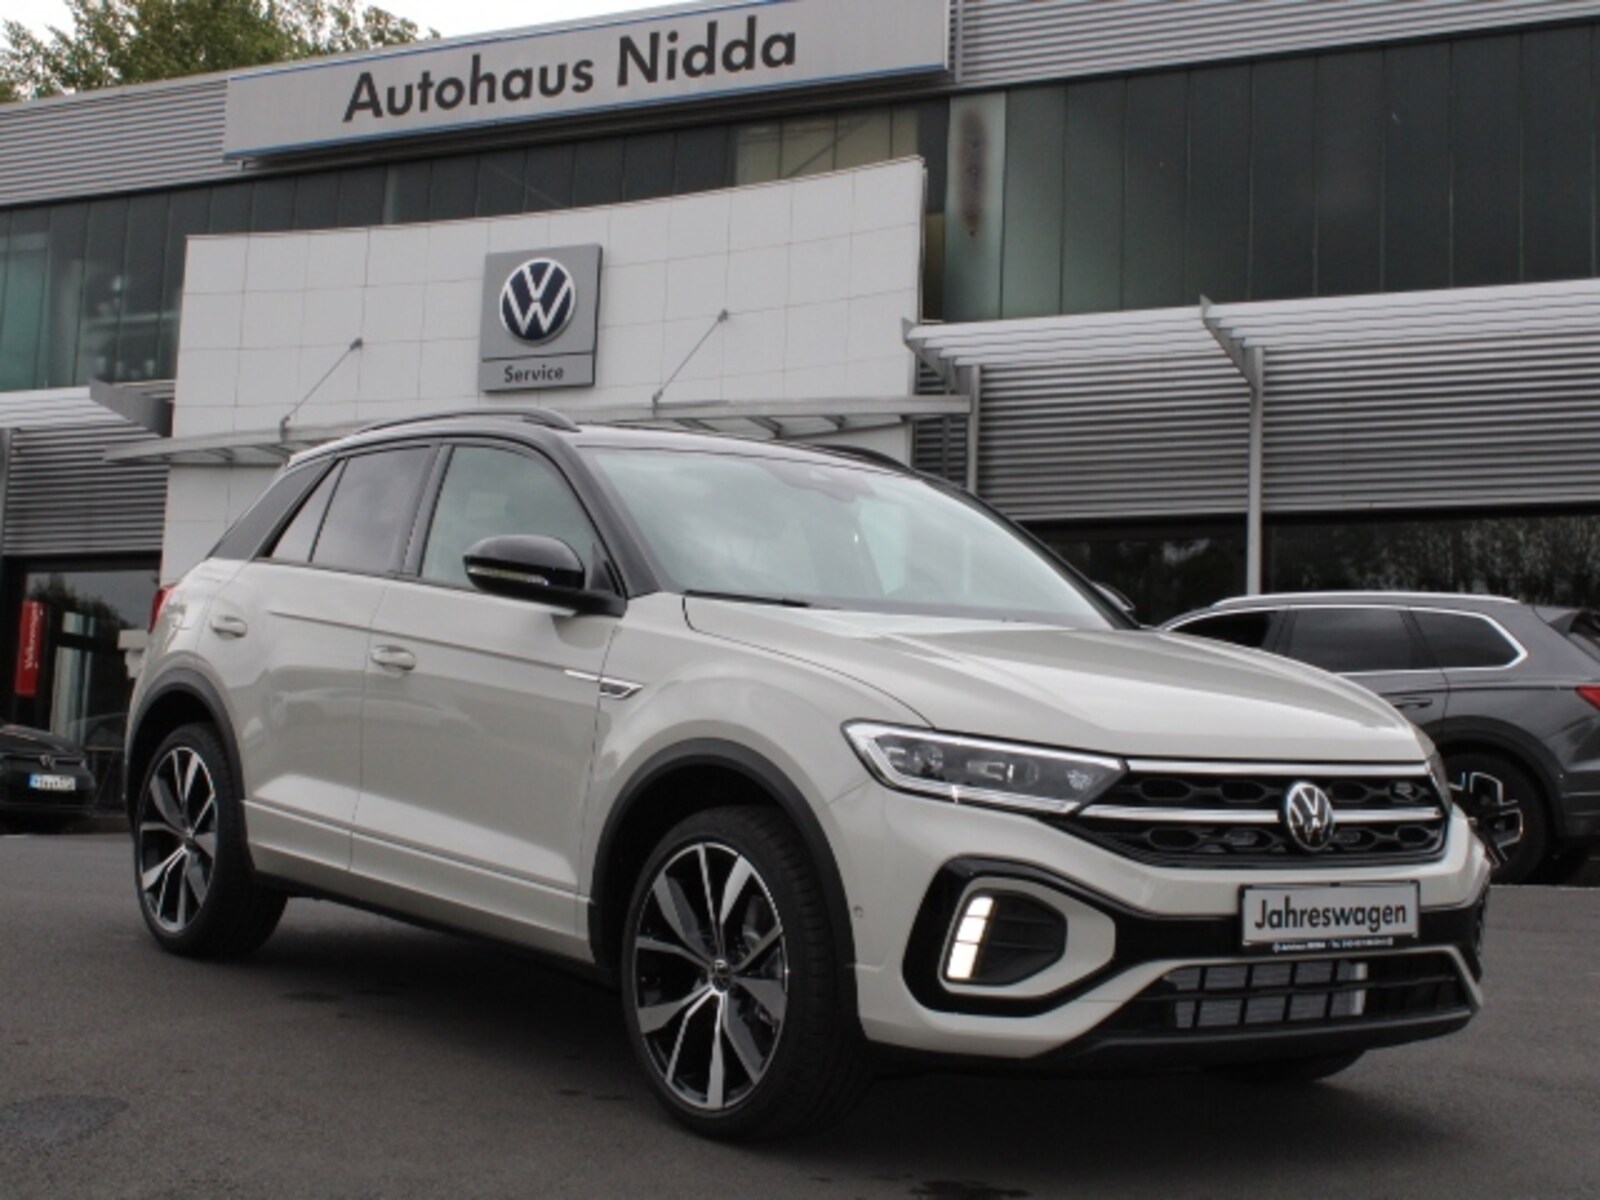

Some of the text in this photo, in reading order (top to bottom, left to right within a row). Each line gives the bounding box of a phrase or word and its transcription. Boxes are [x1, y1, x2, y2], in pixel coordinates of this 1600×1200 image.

[343, 15, 796, 123] Autohaus Nidda
[504, 364, 564, 384] Service
[1254, 895, 1407, 933] Jahreswagen
